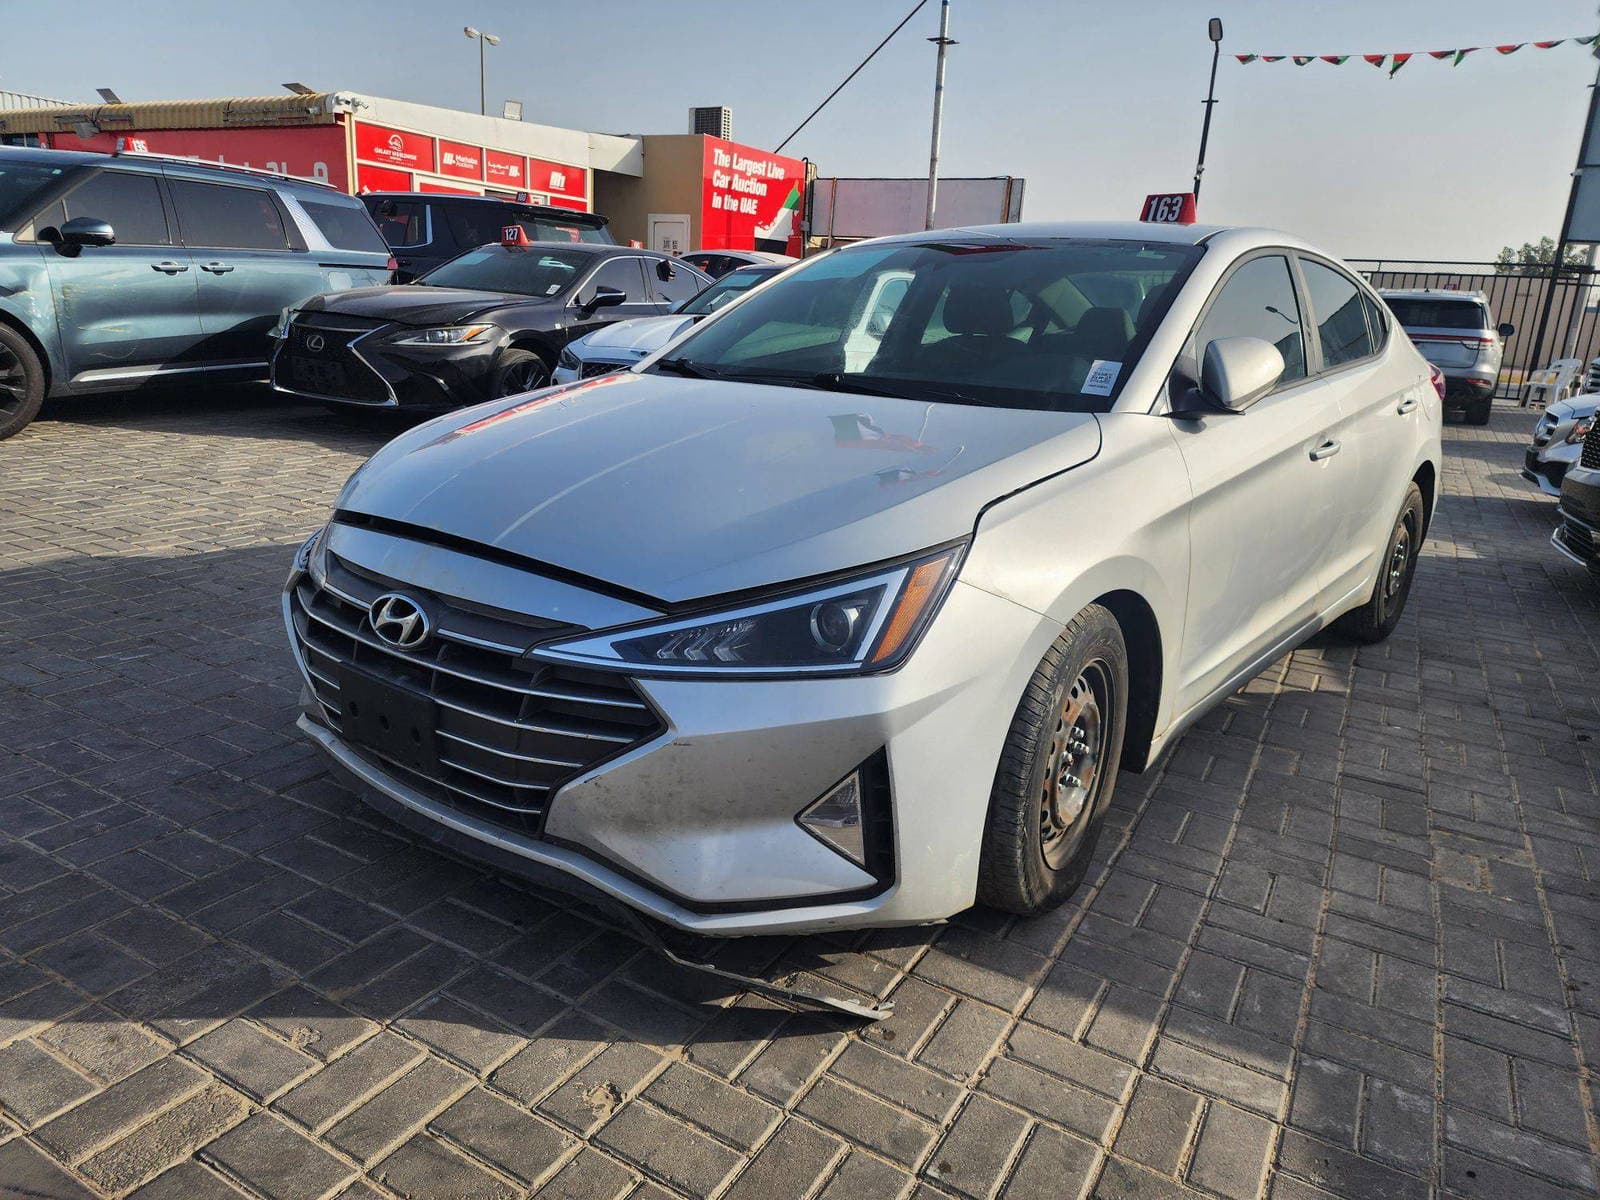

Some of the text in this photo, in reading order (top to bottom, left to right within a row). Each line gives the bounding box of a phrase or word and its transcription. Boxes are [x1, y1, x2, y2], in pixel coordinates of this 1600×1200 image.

[714, 149, 785, 180] The Largest Live
[712, 169, 767, 196] Car Auction
[712, 192, 758, 215] in the UAE
[1148, 196, 1183, 223] 163
[505, 228, 518, 241] 127
